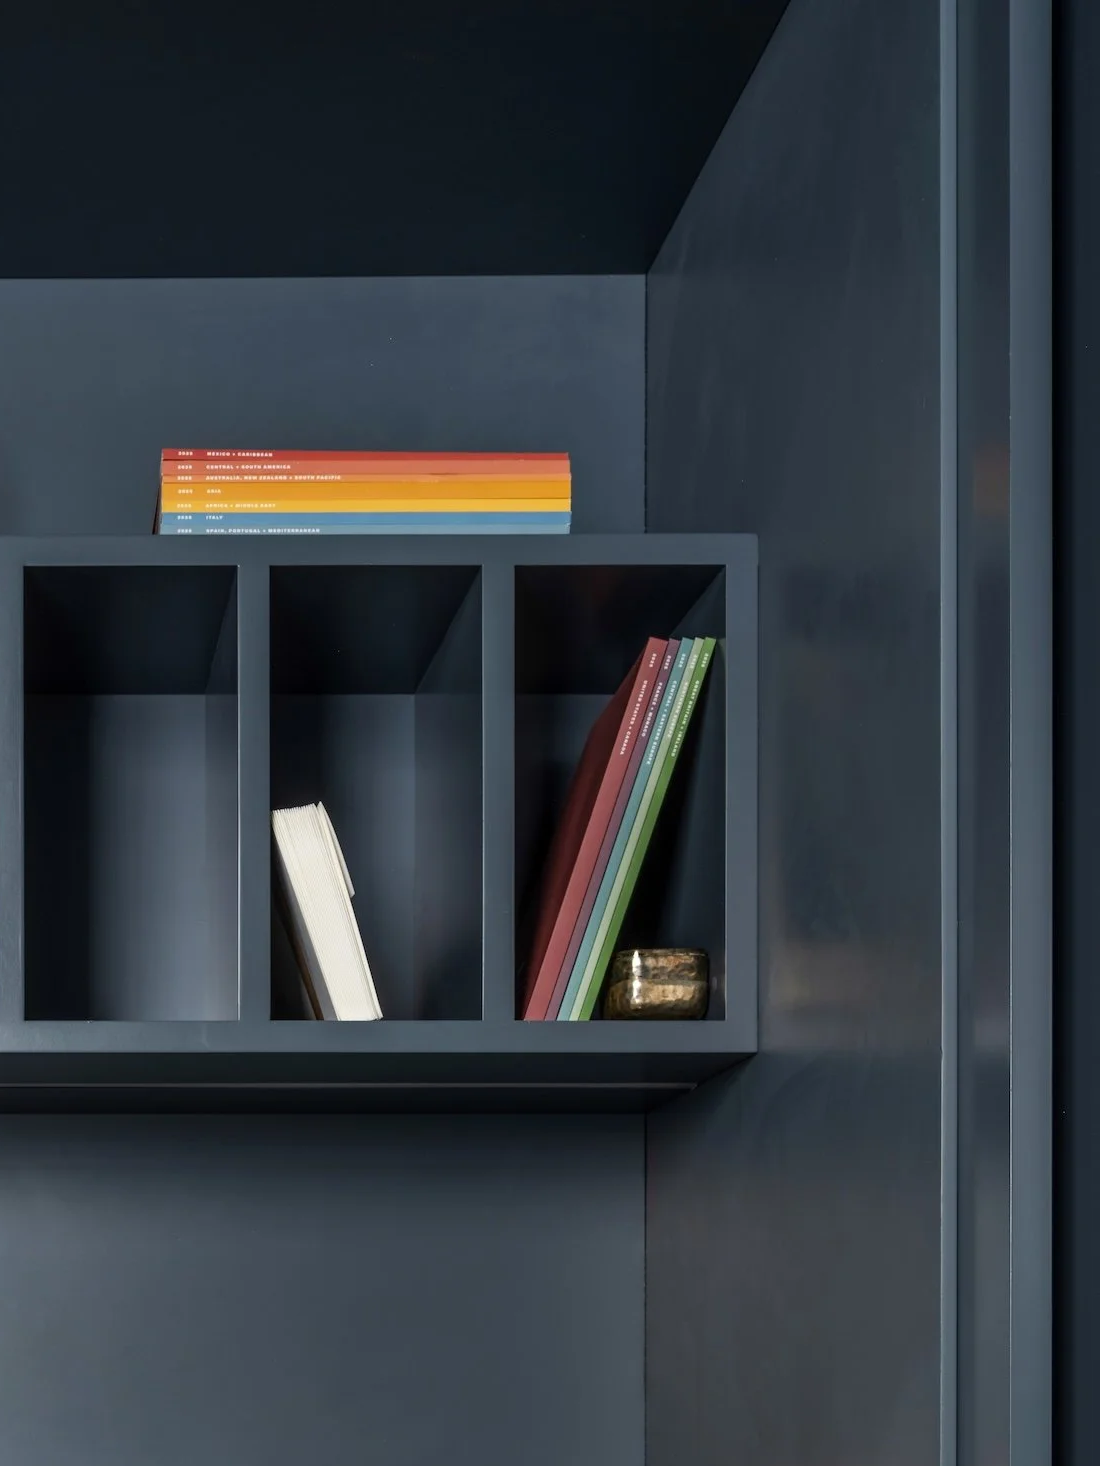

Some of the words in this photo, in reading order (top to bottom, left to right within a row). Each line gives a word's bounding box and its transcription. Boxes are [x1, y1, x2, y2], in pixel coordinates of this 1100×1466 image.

[637, 680, 648, 701] UNITED
[652, 681, 662, 705] FRANCE
[665, 680, 677, 707] CENTRAL
[690, 680, 700, 699] GREAT
[630, 703, 640, 725] STATES
[682, 700, 693, 724] BRITAIN
[641, 712, 653, 737] MONACO
[654, 713, 666, 740] EASTERN
[620, 731, 631, 755] CANADA
[646, 741, 657, 764] EUROPE
[671, 730, 683, 757] IRELAND
